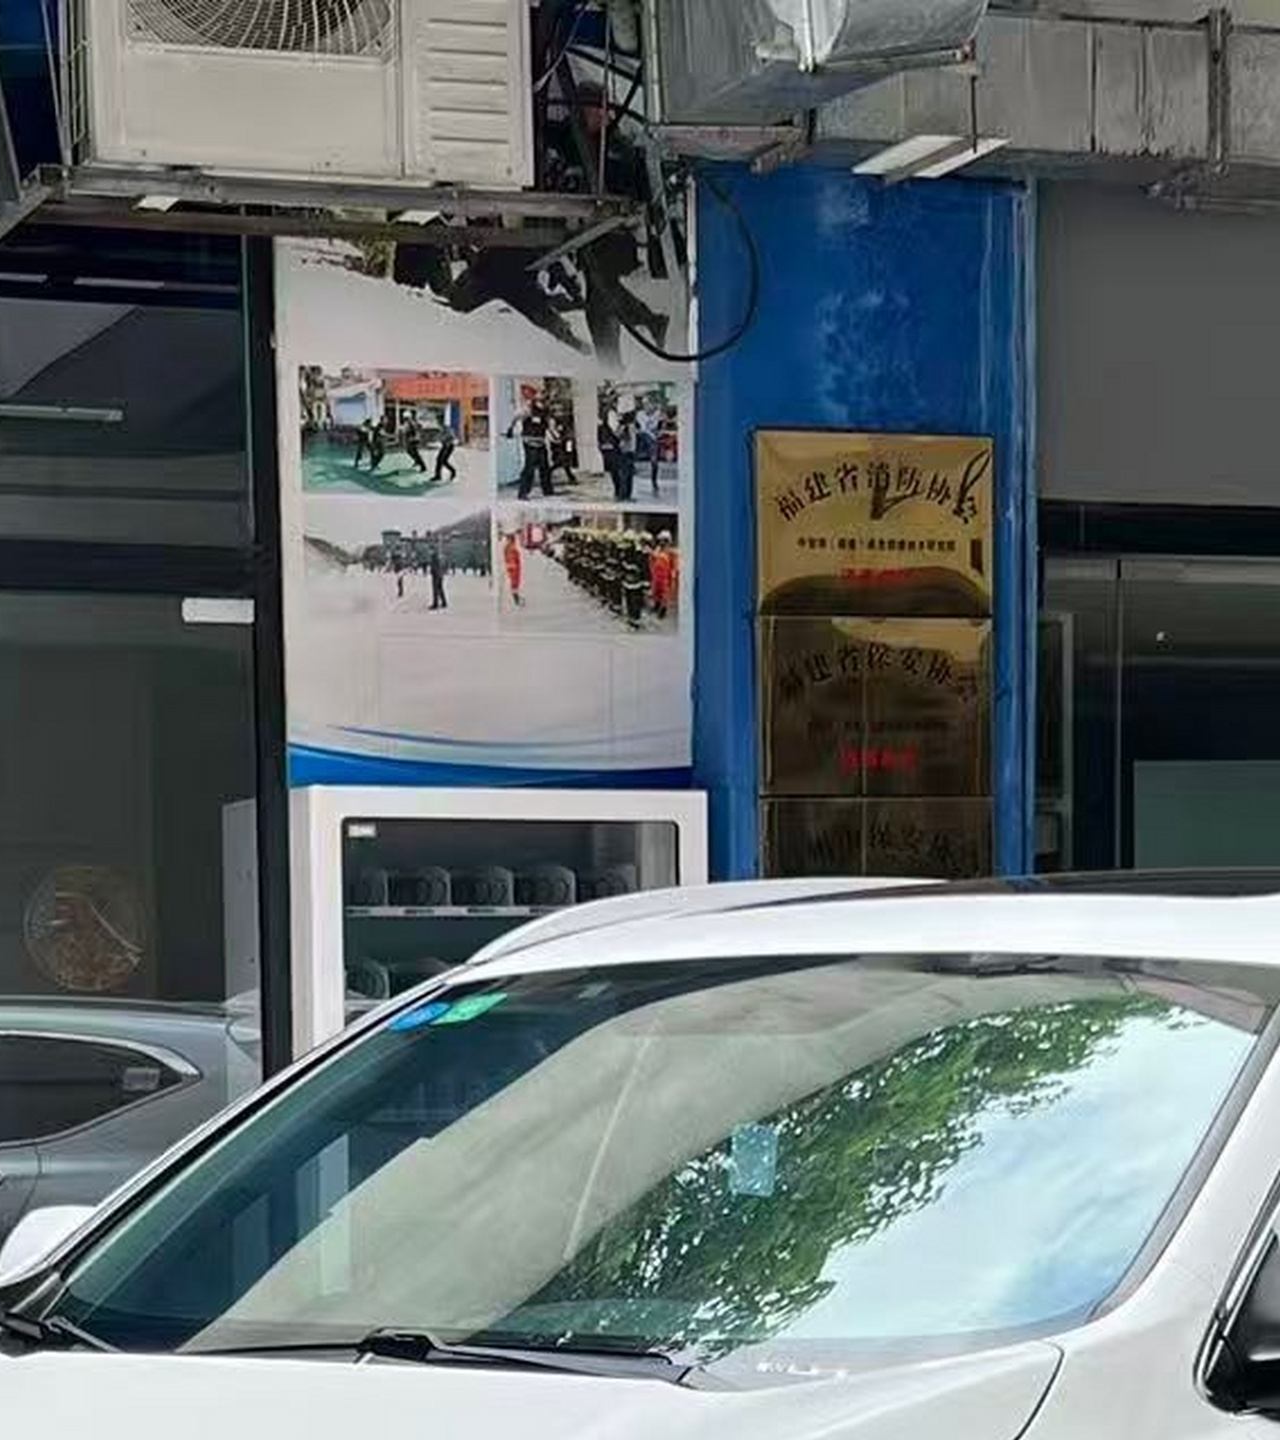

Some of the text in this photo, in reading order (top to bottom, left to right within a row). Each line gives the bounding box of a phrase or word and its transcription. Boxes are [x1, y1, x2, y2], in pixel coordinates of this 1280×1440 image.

[775, 461, 977, 524] 福建省消防协会
